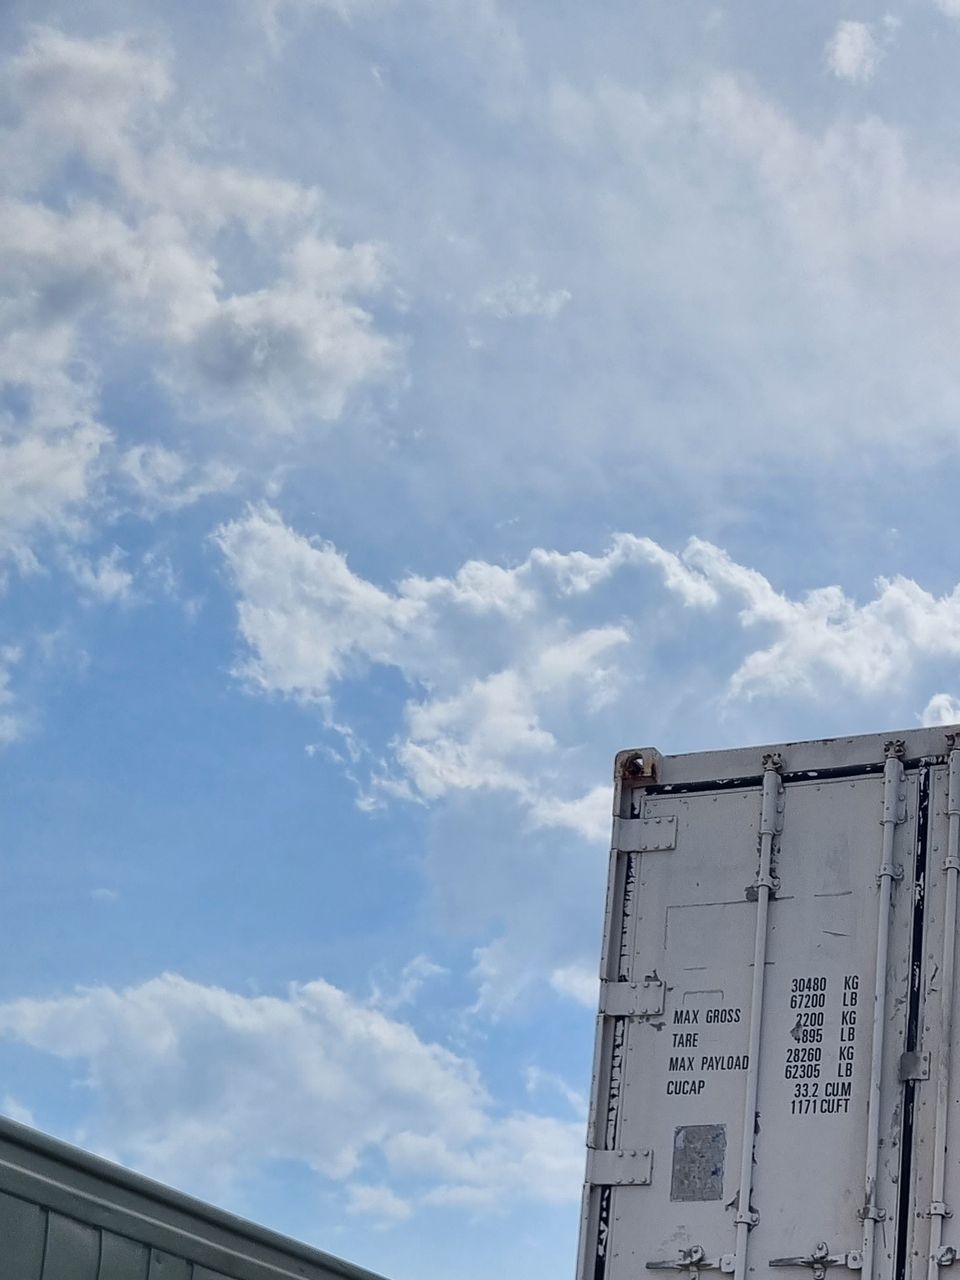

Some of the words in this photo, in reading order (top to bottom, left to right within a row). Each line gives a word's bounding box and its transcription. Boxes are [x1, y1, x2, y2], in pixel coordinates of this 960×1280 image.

[791, 977, 827, 992] 30480
[844, 975, 859, 991] KG
[790, 993, 825, 1009] 67200
[843, 992, 858, 1007] LB
[673, 1009, 699, 1024] MAX
[705, 1008, 741, 1023] GROSS
[796, 1012, 824, 1027] 2200
[841, 1011, 856, 1026] KG
[672, 1033, 699, 1048] TARE
[840, 1027, 855, 1042] LB
[786, 1048, 822, 1063] 28260
[839, 1046, 854, 1061] KG
[668, 1057, 694, 1071] MAX
[701, 1055, 749, 1071] PAYLOAD
[785, 1064, 820, 1079] 62305
[838, 1063, 853, 1078] LB
[666, 1080, 705, 1095] CUCAP
[794, 1083, 819, 1099] 33.2
[791, 1100, 817, 1114] 1171
